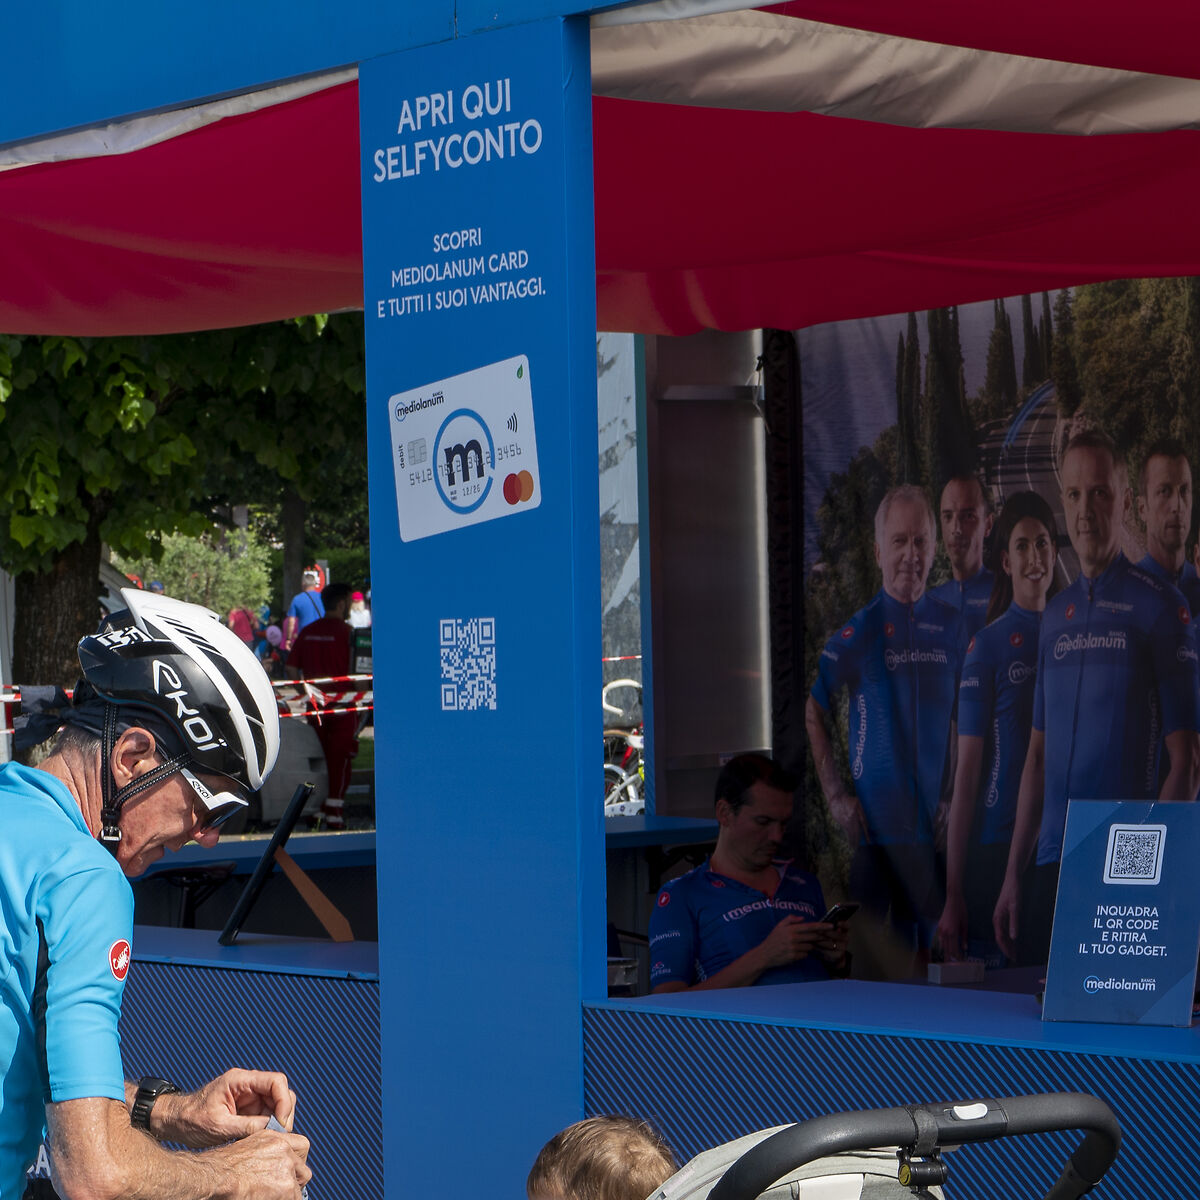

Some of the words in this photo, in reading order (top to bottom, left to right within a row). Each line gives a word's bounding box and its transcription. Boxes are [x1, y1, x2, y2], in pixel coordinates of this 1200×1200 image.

[397, 90, 453, 135] APRI
[461, 78, 511, 119] QUI
[373, 118, 543, 183] SELFYCONTO
[433, 227, 482, 253] SCOPRI
[391, 256, 485, 288] MEDIOLANUM
[488, 249, 529, 273] CARD
[377, 300, 386, 318] E
[387, 294, 424, 316] TUTTI
[427, 292, 432, 312] I
[434, 287, 468, 310] SUOI
[469, 276, 546, 304] VANTAGGI.
[396, 394, 445, 418] mediolanum
[1055, 633, 1126, 657] mediolanum
[1096, 905, 1159, 917] INQUADRA
[1093, 918, 1103, 929] IL
[1106, 918, 1123, 930] QR
[1125, 919, 1159, 931] CODE
[1101, 931, 1109, 942] E
[1111, 931, 1148, 943] RITIRA
[1079, 943, 1088, 954] IL
[1091, 944, 1116, 955] TUO
[1118, 945, 1168, 957] GADGET.
[1086, 978, 1156, 992] mediolanum
